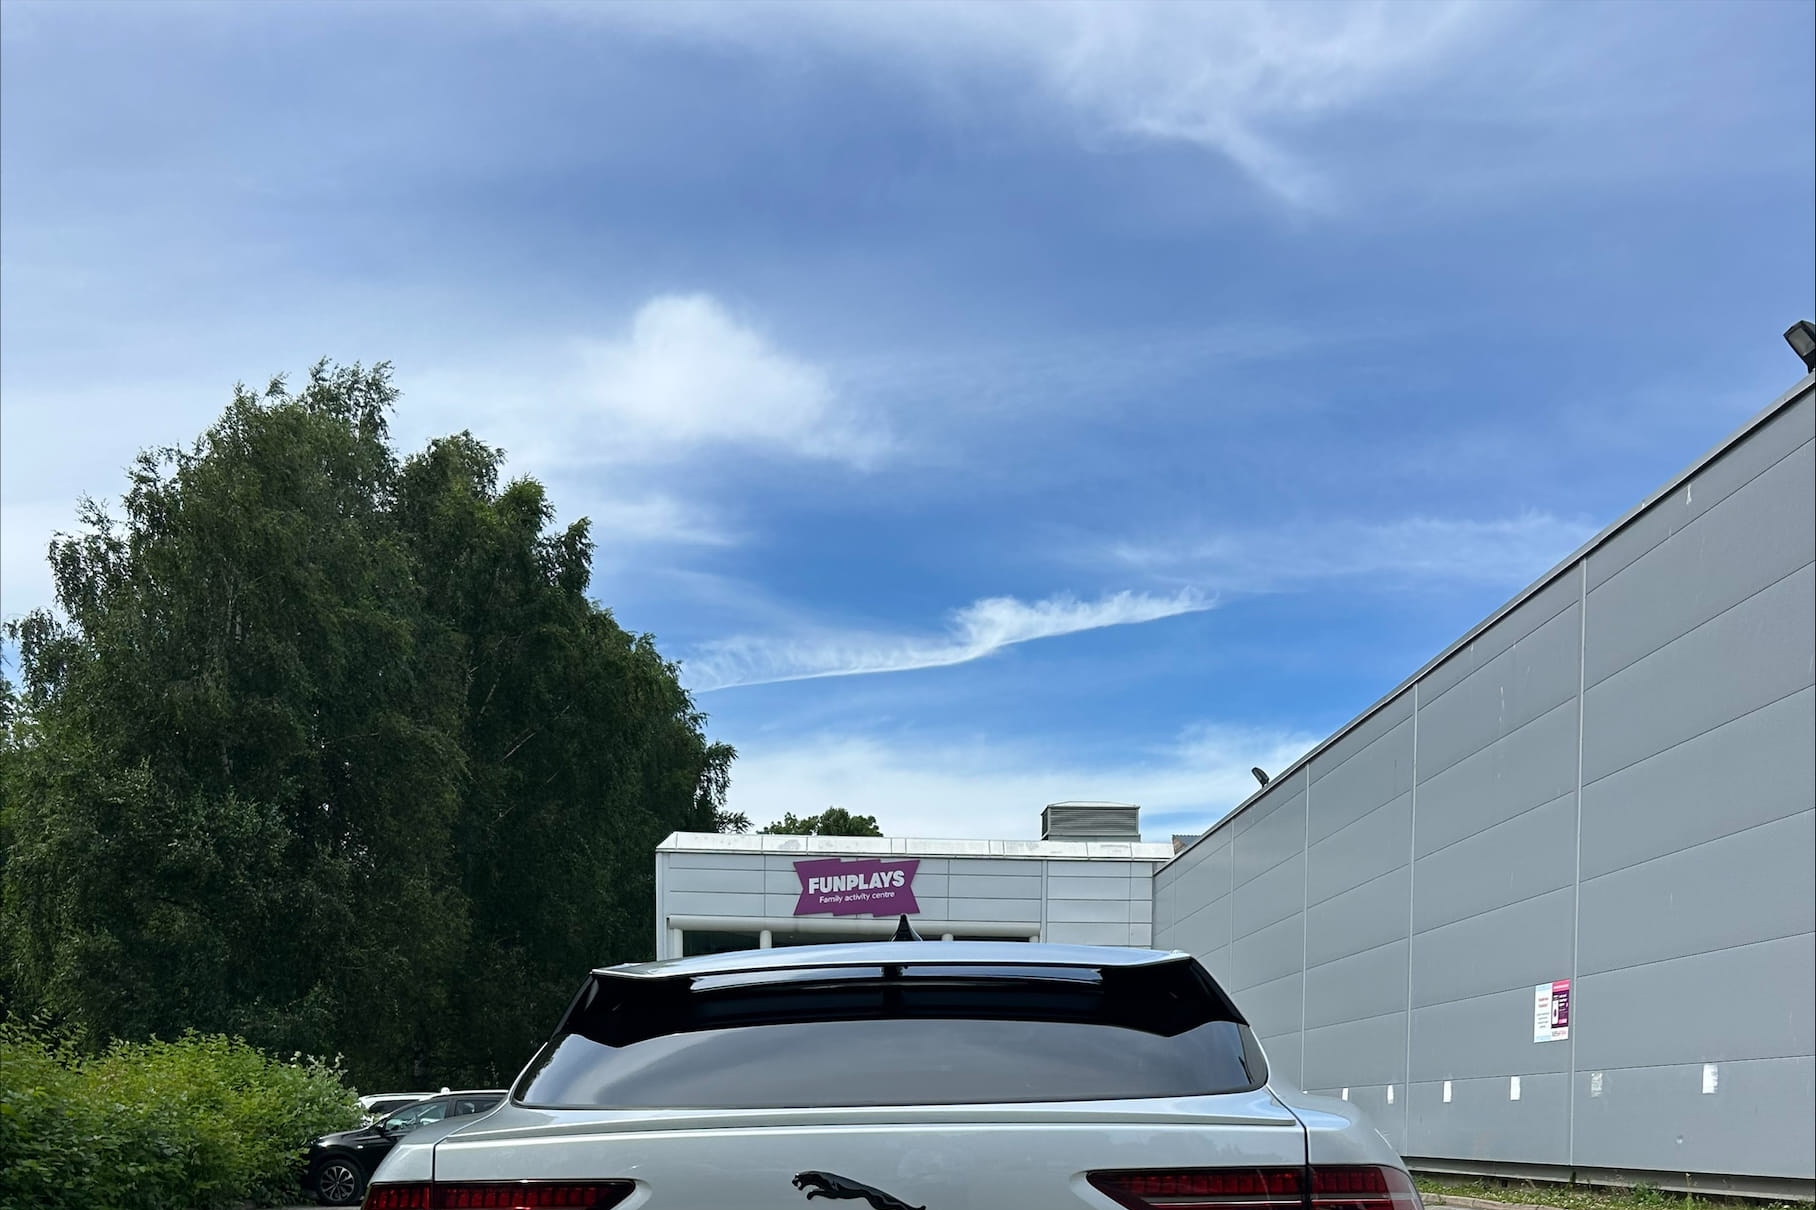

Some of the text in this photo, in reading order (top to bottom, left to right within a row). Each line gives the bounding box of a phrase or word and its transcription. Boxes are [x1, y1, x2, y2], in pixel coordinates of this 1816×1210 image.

[808, 870, 905, 894] FUNPLAYS
[819, 891, 895, 904] Family activity centre
